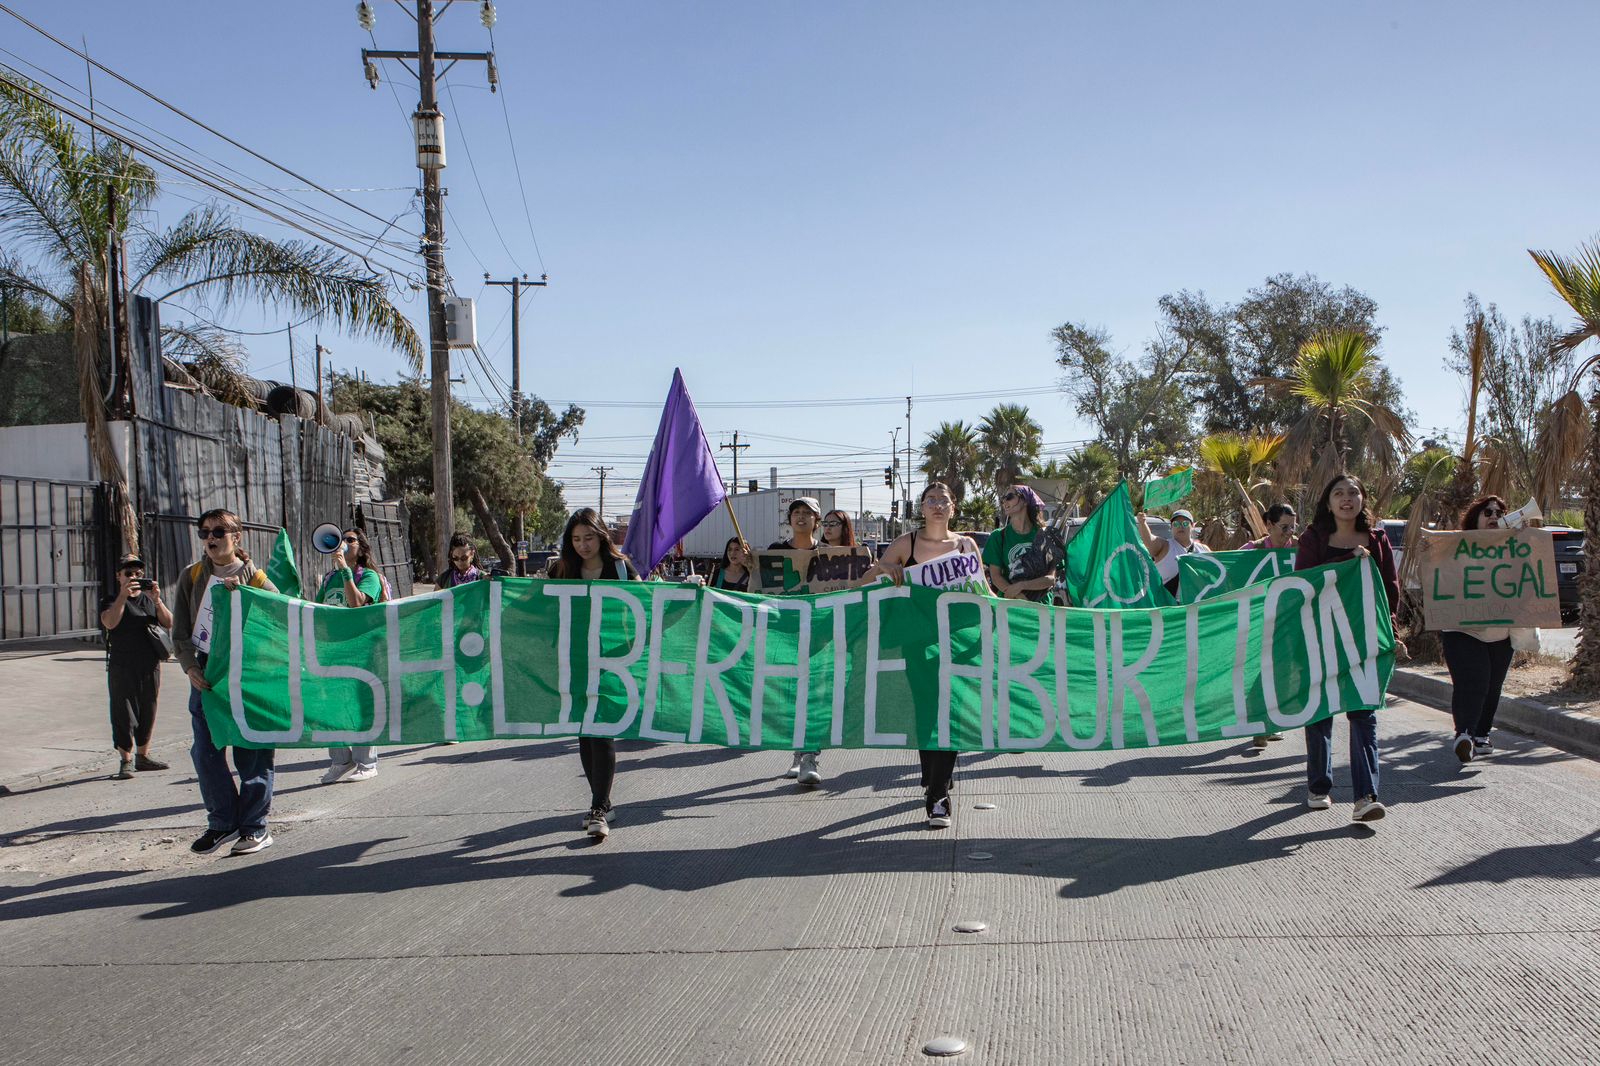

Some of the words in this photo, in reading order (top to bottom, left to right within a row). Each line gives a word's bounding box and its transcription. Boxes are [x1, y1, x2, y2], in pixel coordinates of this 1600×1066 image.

[1454, 536, 1532, 560] Aborto
[921, 554, 979, 587] CUERPO
[1433, 559, 1556, 601] LEGAL
[936, 557, 1380, 750] ABORTION
